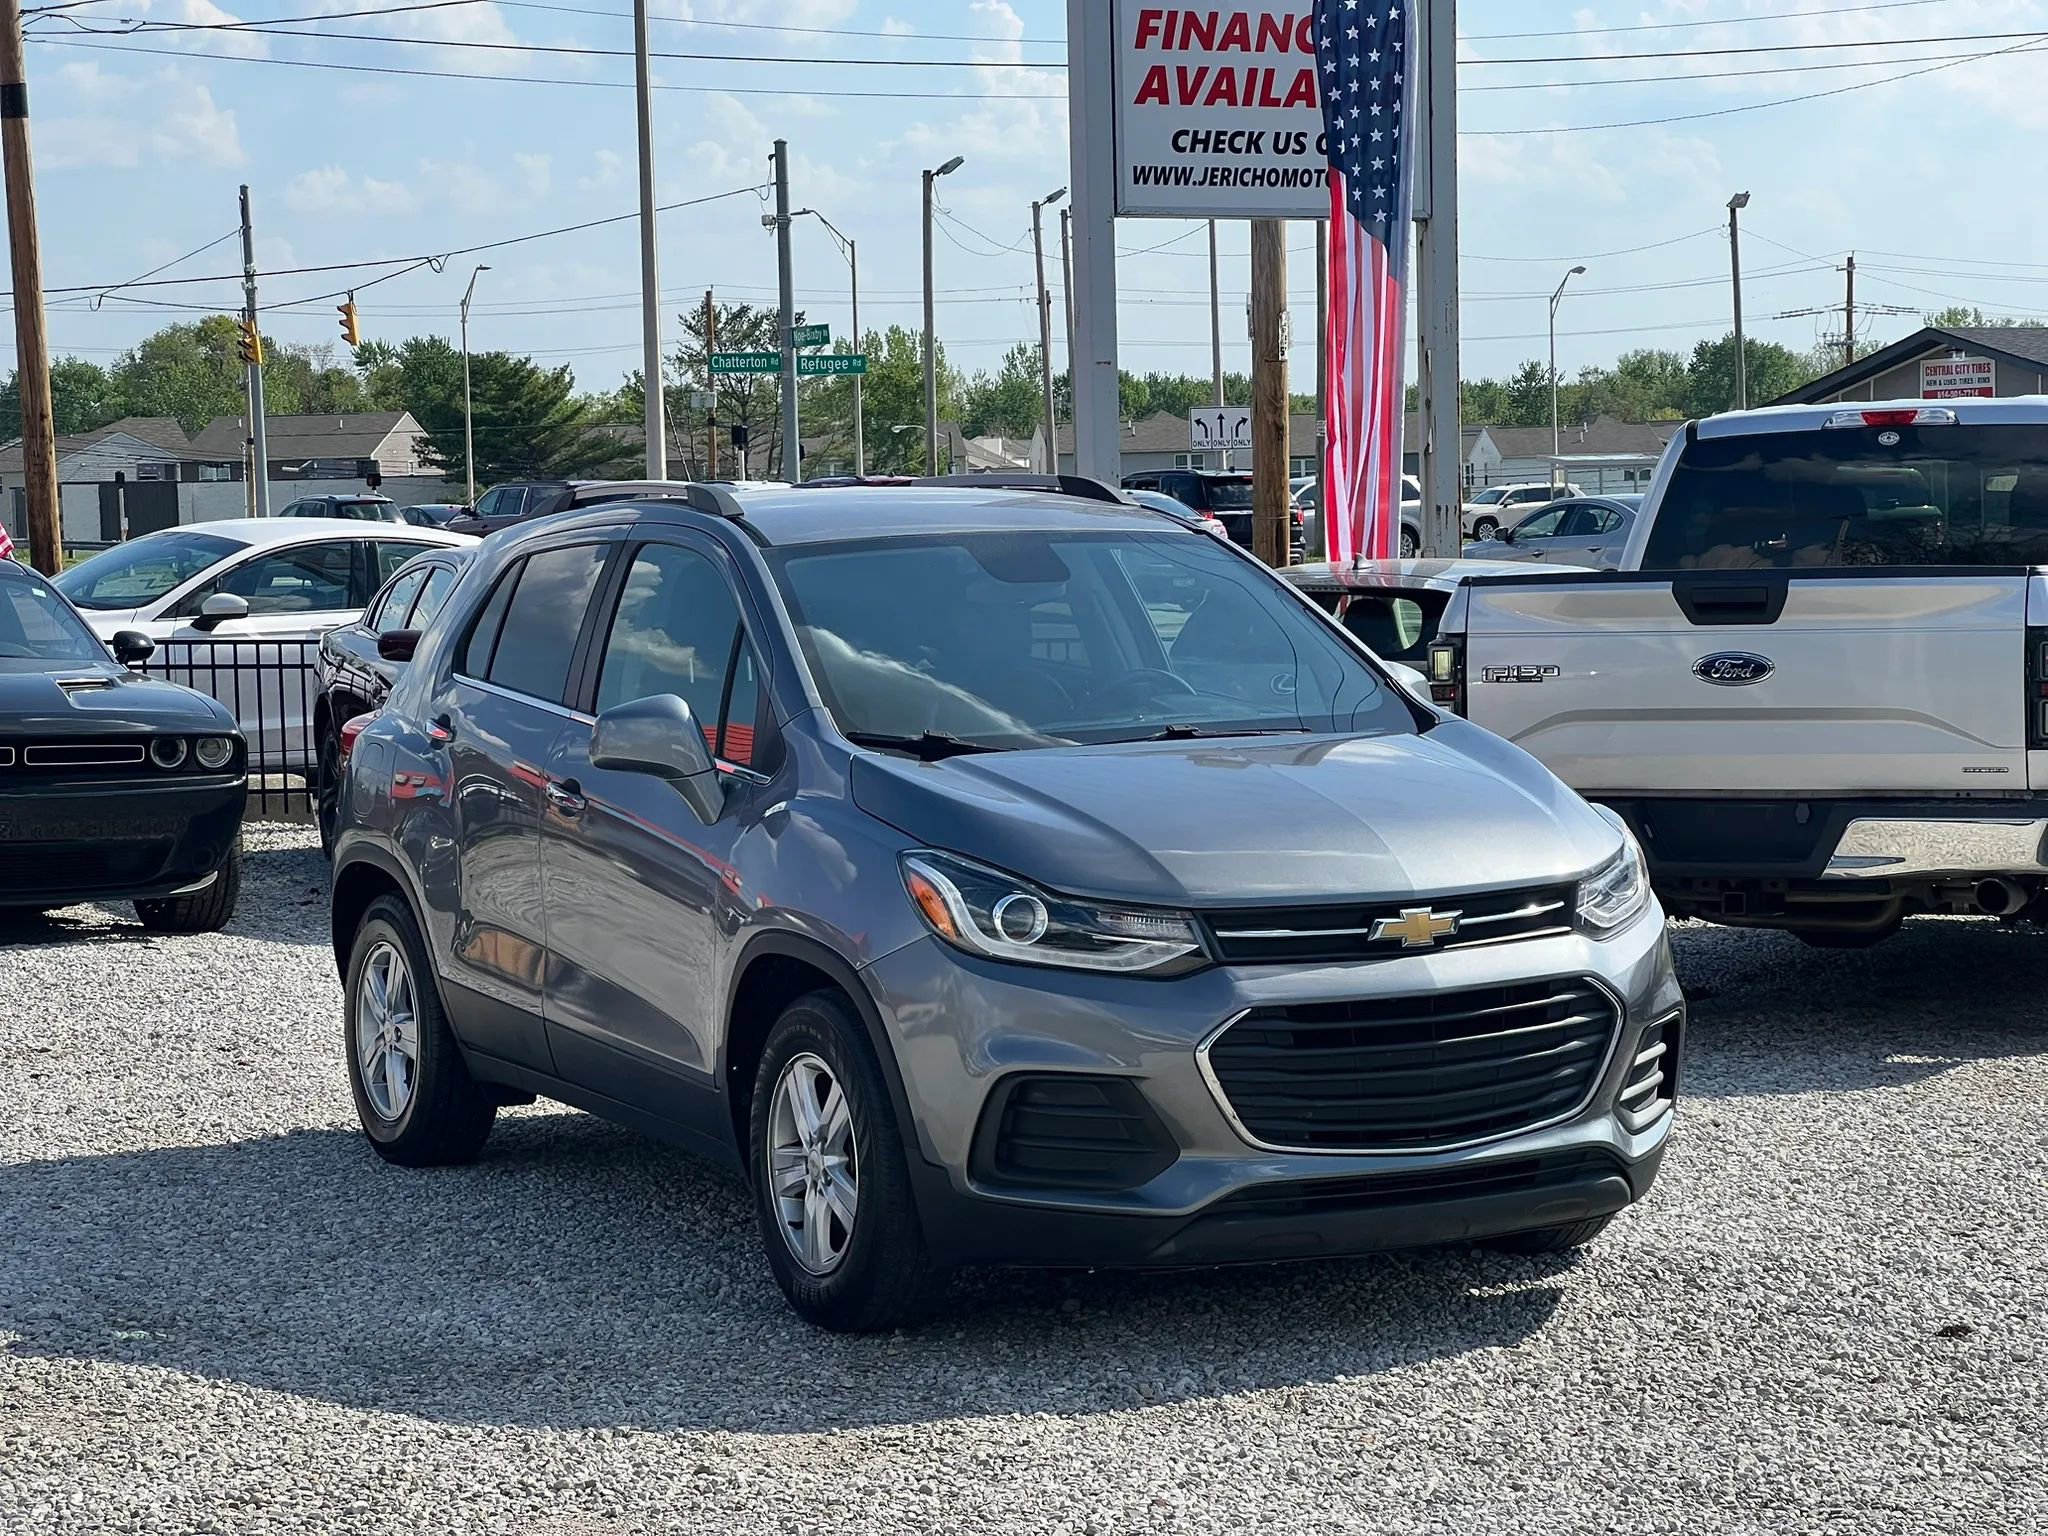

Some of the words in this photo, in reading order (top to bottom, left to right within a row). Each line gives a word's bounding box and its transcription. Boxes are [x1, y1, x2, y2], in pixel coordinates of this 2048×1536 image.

[1134, 65, 1317, 108] AVAILA
[1171, 129, 1266, 155] CHECK
[1272, 131, 1308, 156] US
[711, 355, 768, 369] Chatterton
[770, 357, 779, 366] Rd
[800, 357, 849, 373] Refugee
[852, 358, 862, 368] Rd
[1925, 364, 1954, 377] CENTRAL
[1955, 363, 1971, 375] CITY
[1971, 362, 1991, 374] TIRES
[1944, 378, 1958, 386] USED
[1959, 377, 1973, 385] TIRES
[1233, 439, 1251, 447] ONLY
[1711, 659, 1755, 678] Ford
